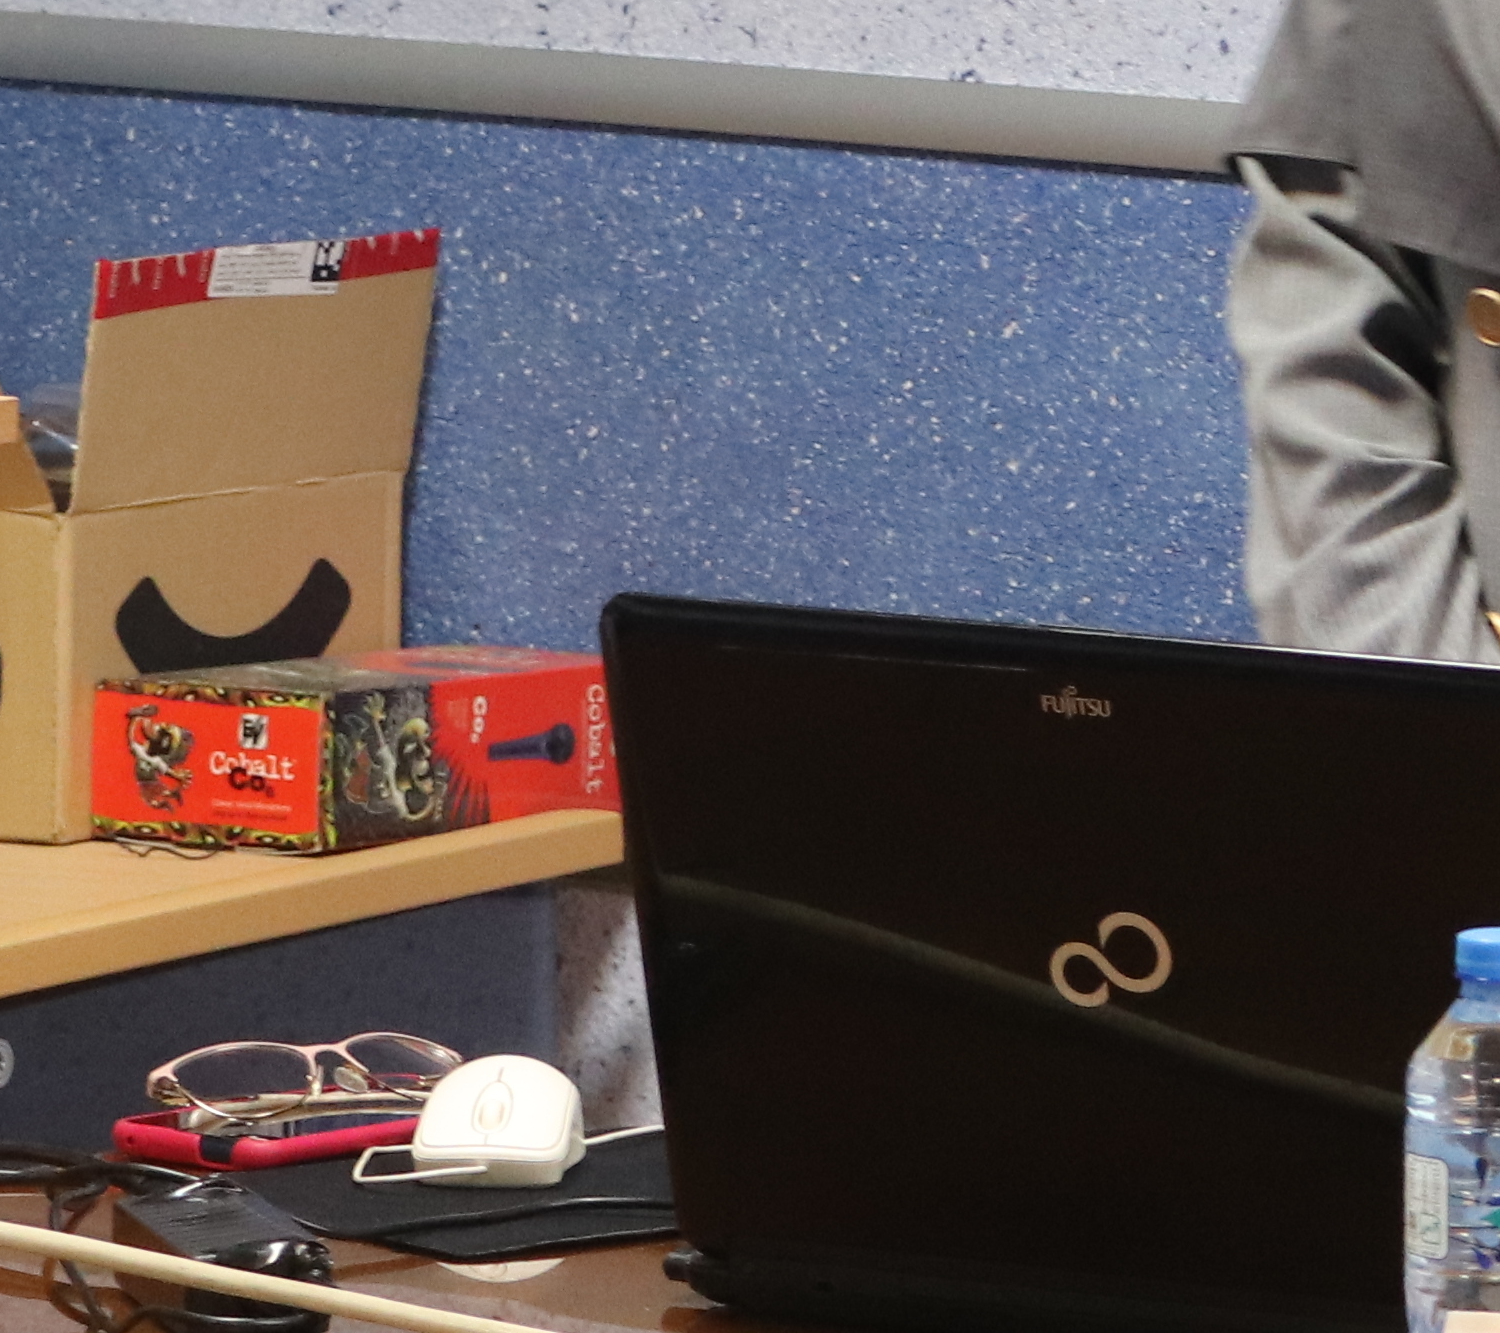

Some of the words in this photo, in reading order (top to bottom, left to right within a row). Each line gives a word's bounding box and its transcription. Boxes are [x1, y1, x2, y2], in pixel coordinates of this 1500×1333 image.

[1041, 685, 1112, 718] FUJITSU
[585, 684, 606, 794] Cobalt
[208, 750, 296, 781] Cobalt
